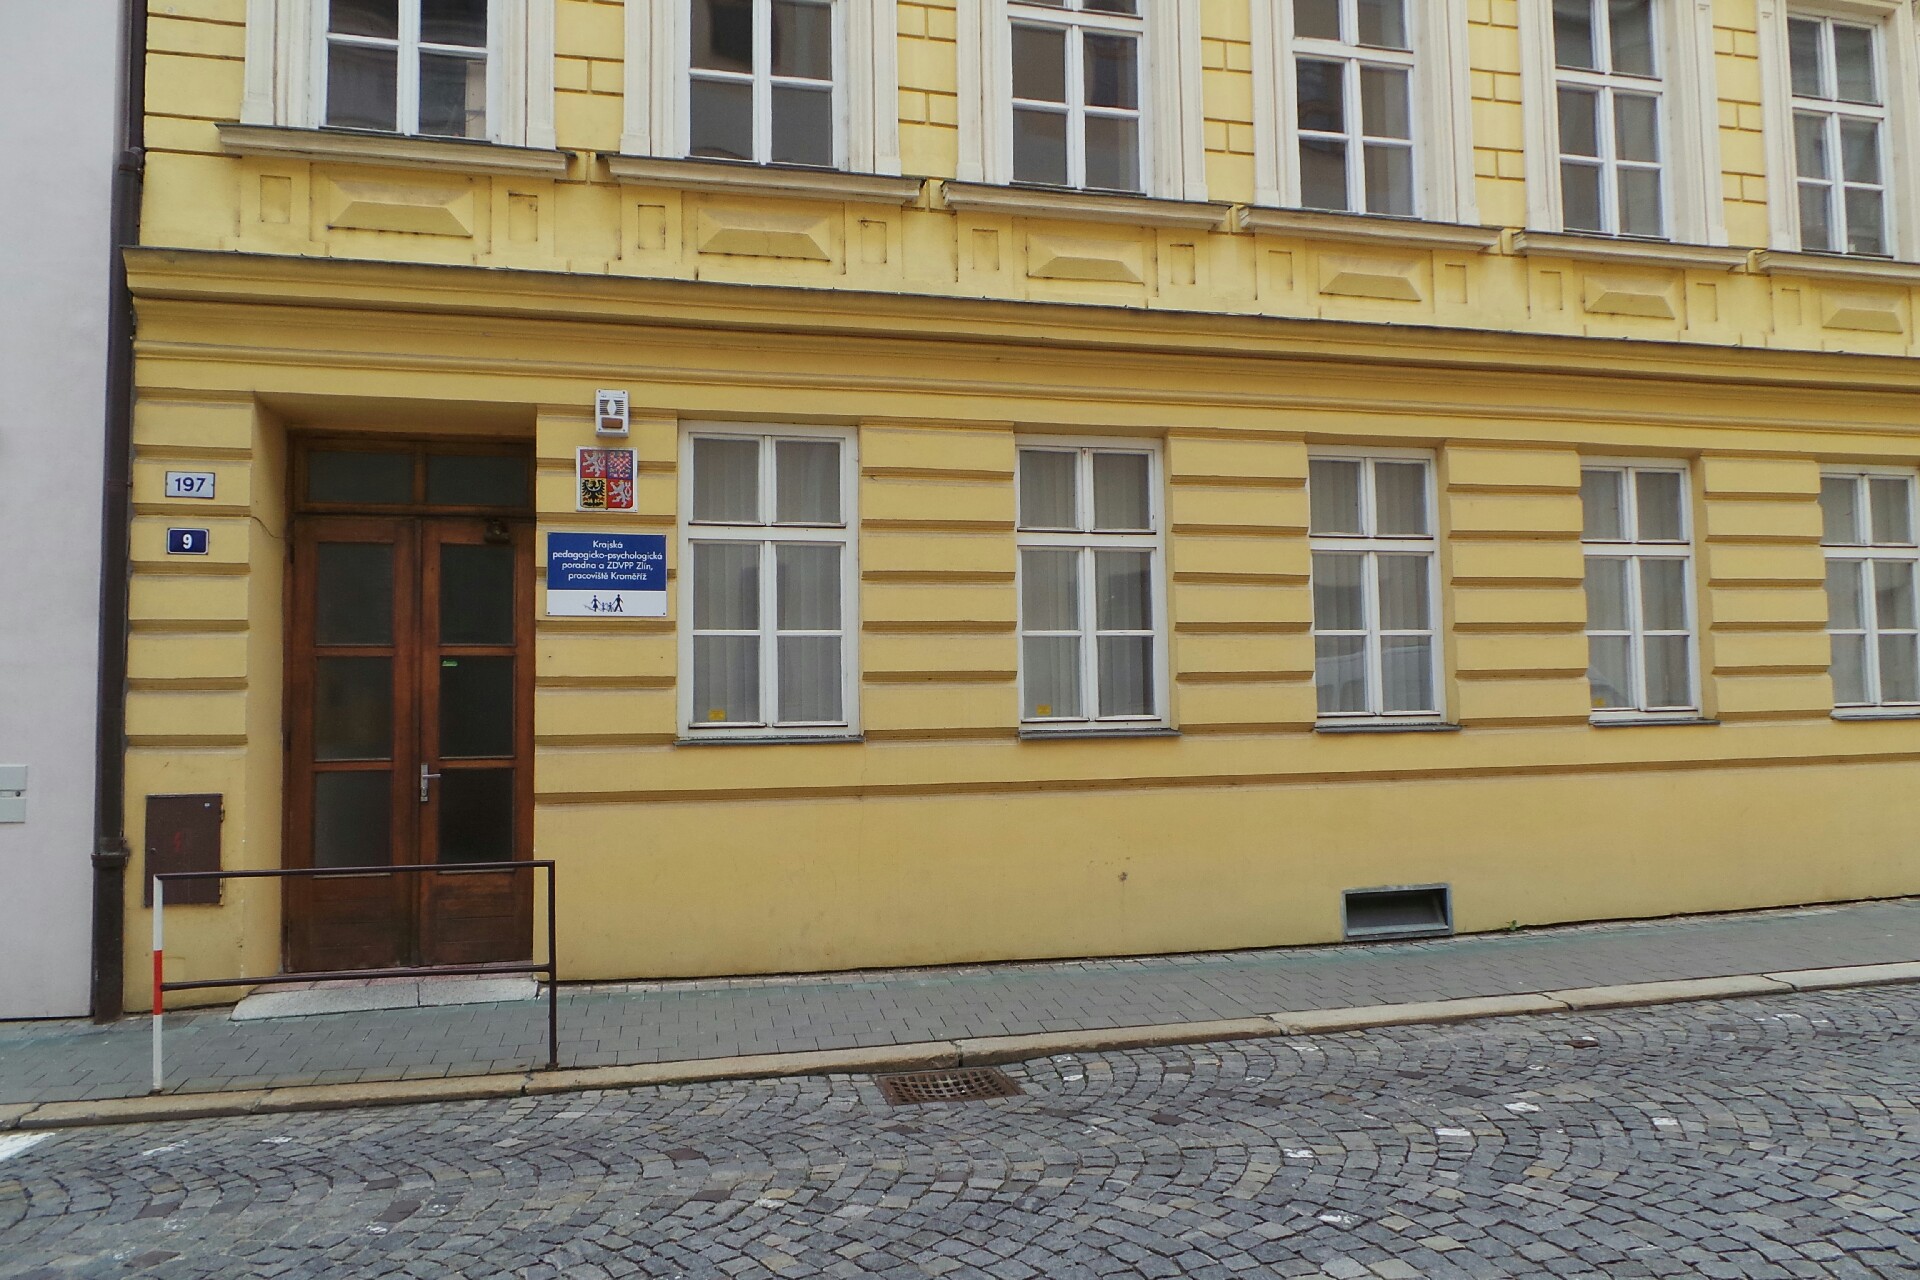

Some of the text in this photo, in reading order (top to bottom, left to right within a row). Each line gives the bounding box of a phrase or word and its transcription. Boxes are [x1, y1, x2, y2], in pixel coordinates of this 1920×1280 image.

[175, 476, 207, 492] 197
[182, 533, 193, 550] 9
[592, 540, 623, 550] Krajská
[552, 550, 663, 561] pedagogicko-psychologická
[562, 561, 597, 570] poradna
[606, 561, 634, 570] ZDVPP
[636, 562, 654, 571] Zlín,
[568, 571, 648, 581] pracoviště Kroměříž
